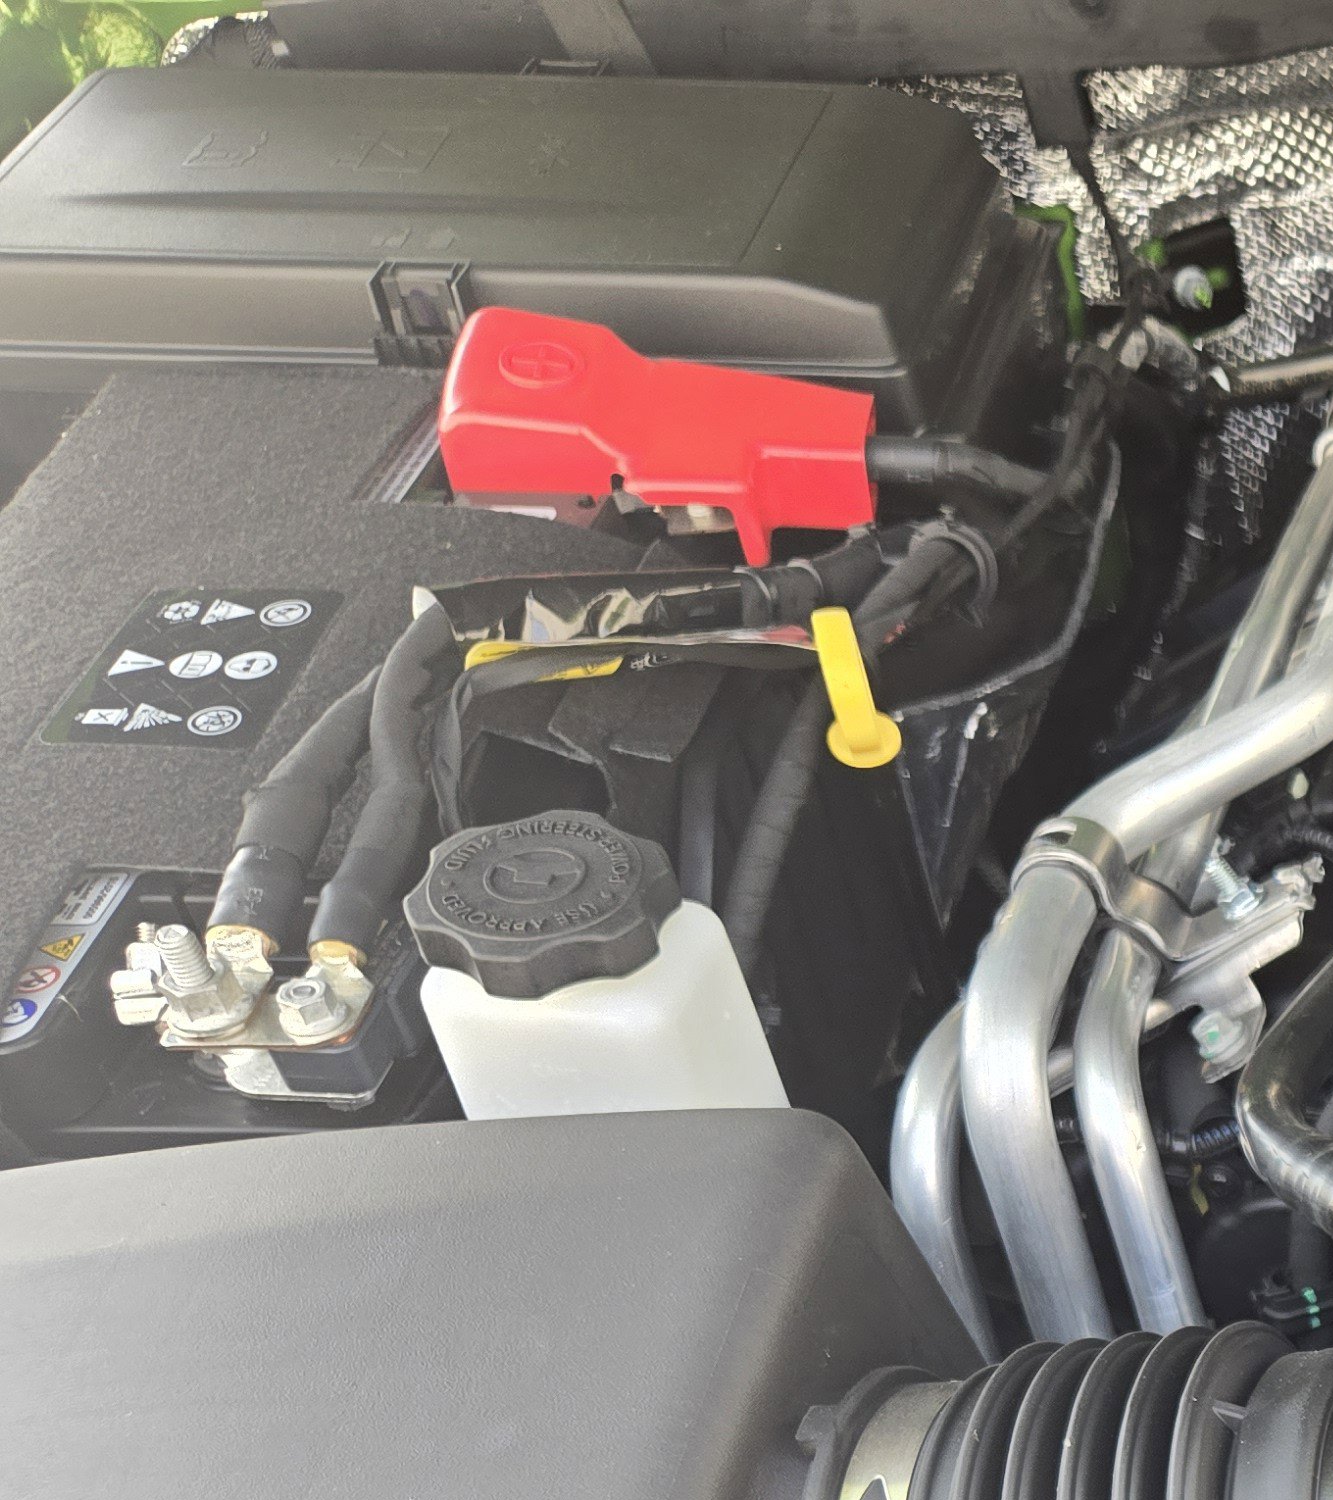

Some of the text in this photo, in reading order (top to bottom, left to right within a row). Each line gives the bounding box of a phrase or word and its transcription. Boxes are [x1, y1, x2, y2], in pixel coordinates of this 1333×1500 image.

[496, 820, 602, 841] STEERING
[441, 893, 598, 932] USE APPROVED
